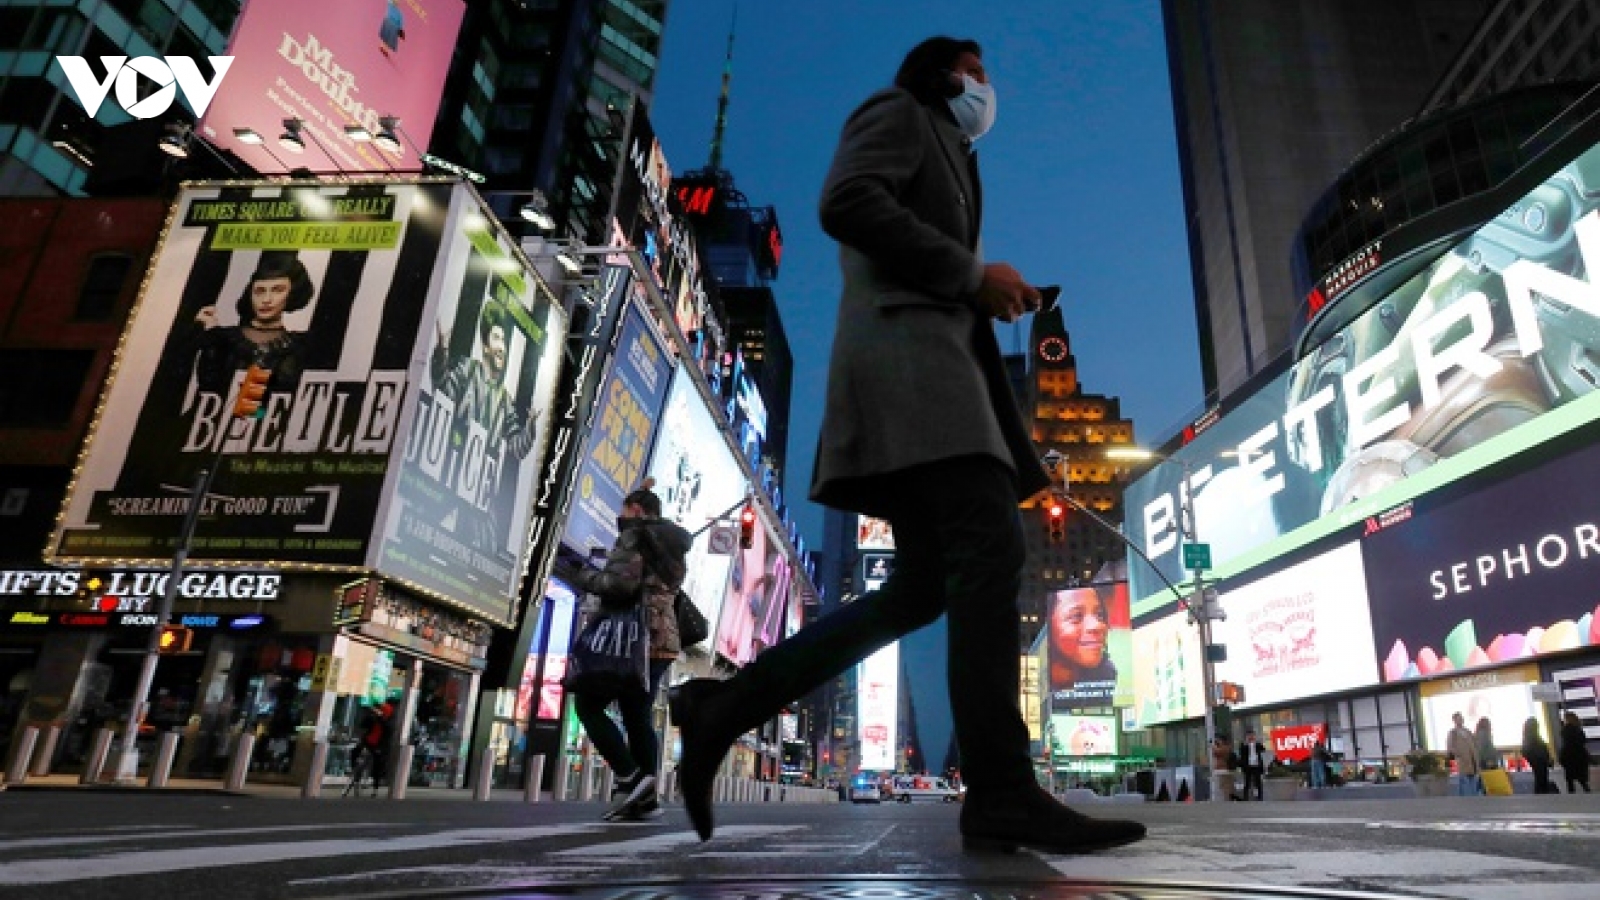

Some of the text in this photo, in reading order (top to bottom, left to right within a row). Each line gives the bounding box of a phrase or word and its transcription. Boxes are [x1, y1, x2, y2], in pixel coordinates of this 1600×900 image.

[192, 201, 237, 220] TIMES
[238, 201, 296, 219] SQUARE
[219, 228, 266, 244] MAKE
[270, 228, 299, 243] YOU
[303, 227, 339, 243] FEEL
[107, 498, 218, 515] "SCREAMINLY
[223, 497, 268, 515] GOOD
[1429, 522, 1600, 600] SEPHOR
[591, 618, 639, 659] GAP
